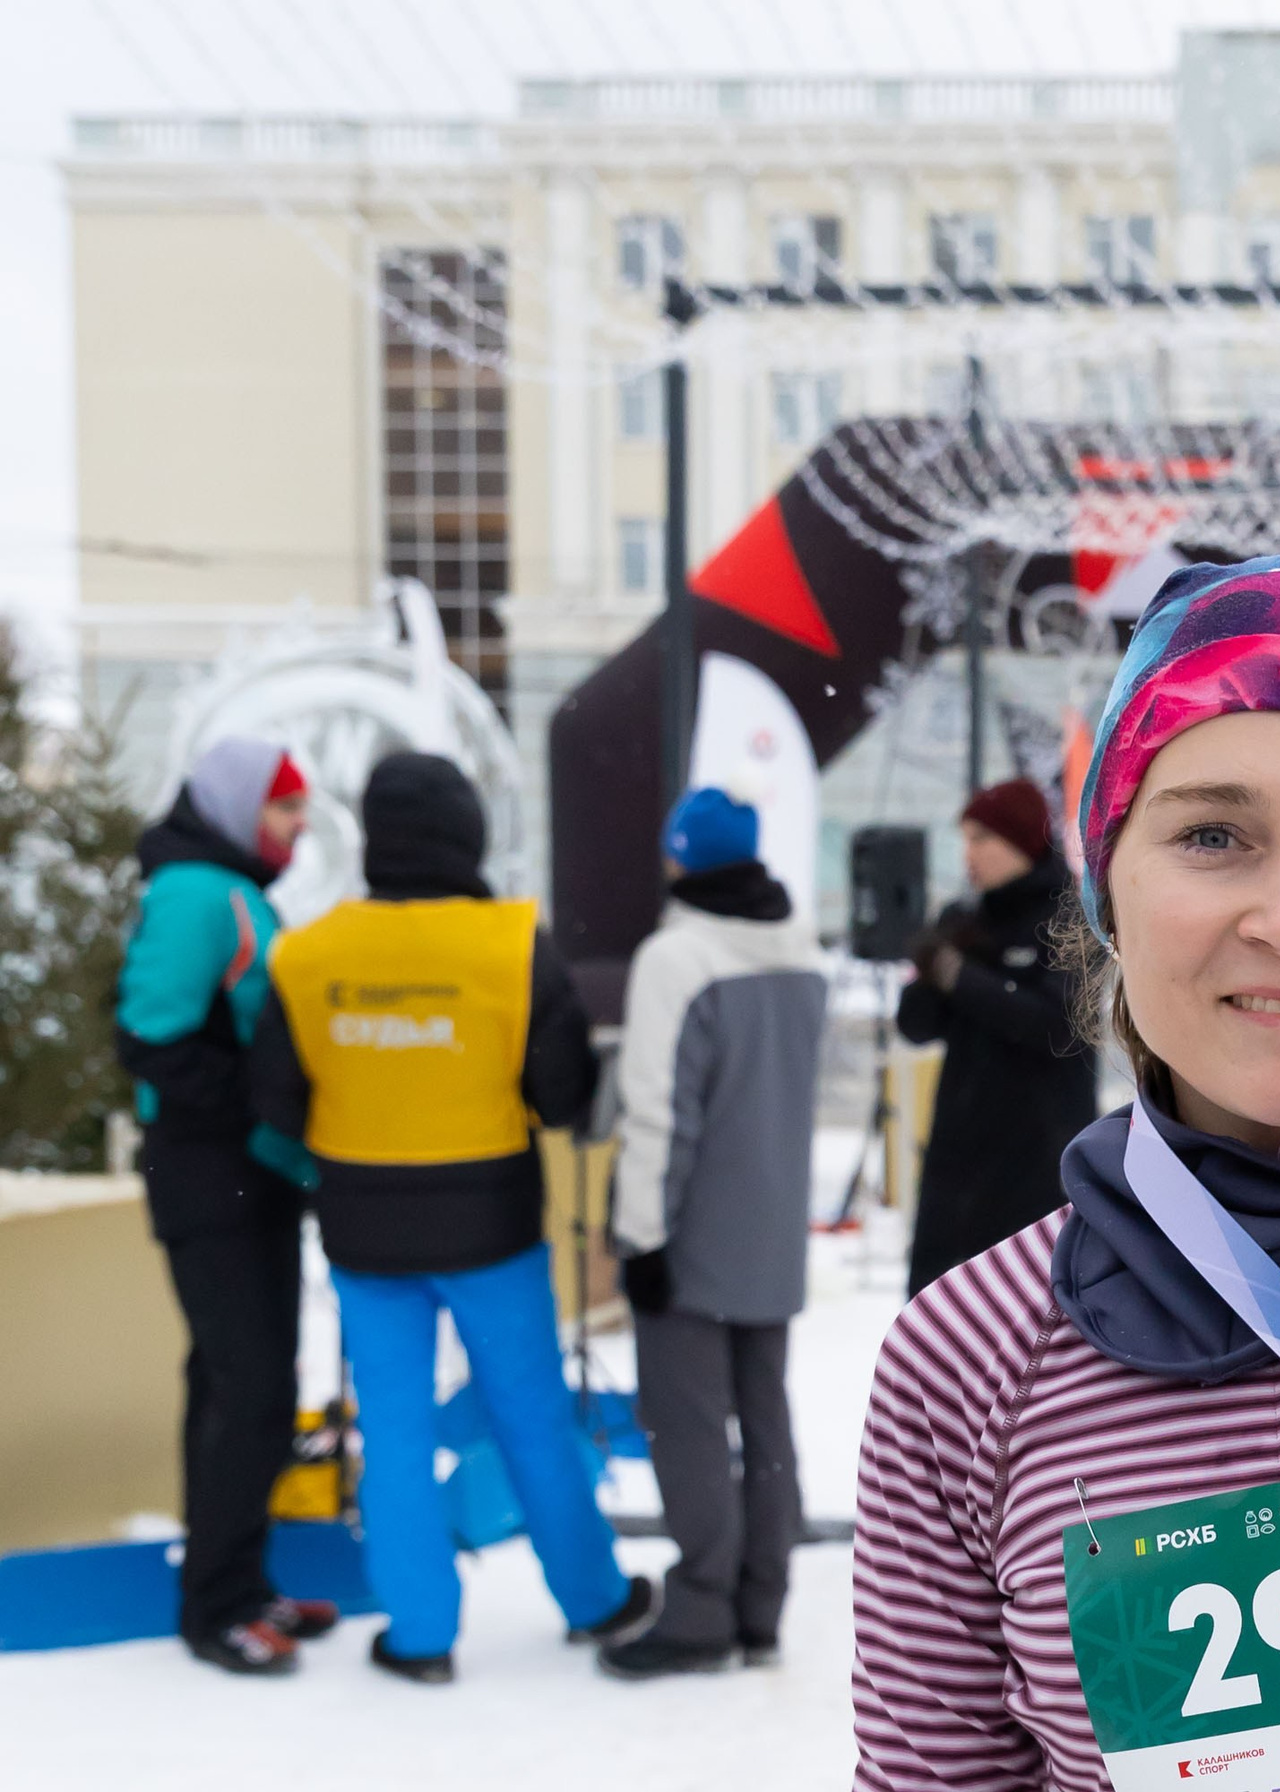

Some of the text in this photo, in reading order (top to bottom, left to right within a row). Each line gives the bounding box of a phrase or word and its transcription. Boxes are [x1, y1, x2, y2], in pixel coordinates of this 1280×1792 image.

[1156, 1524, 1217, 1552] РСХБ
[1197, 1748, 1265, 1767] КАЛАШНИКОВ
[1199, 1763, 1230, 1776] СПОРТ
